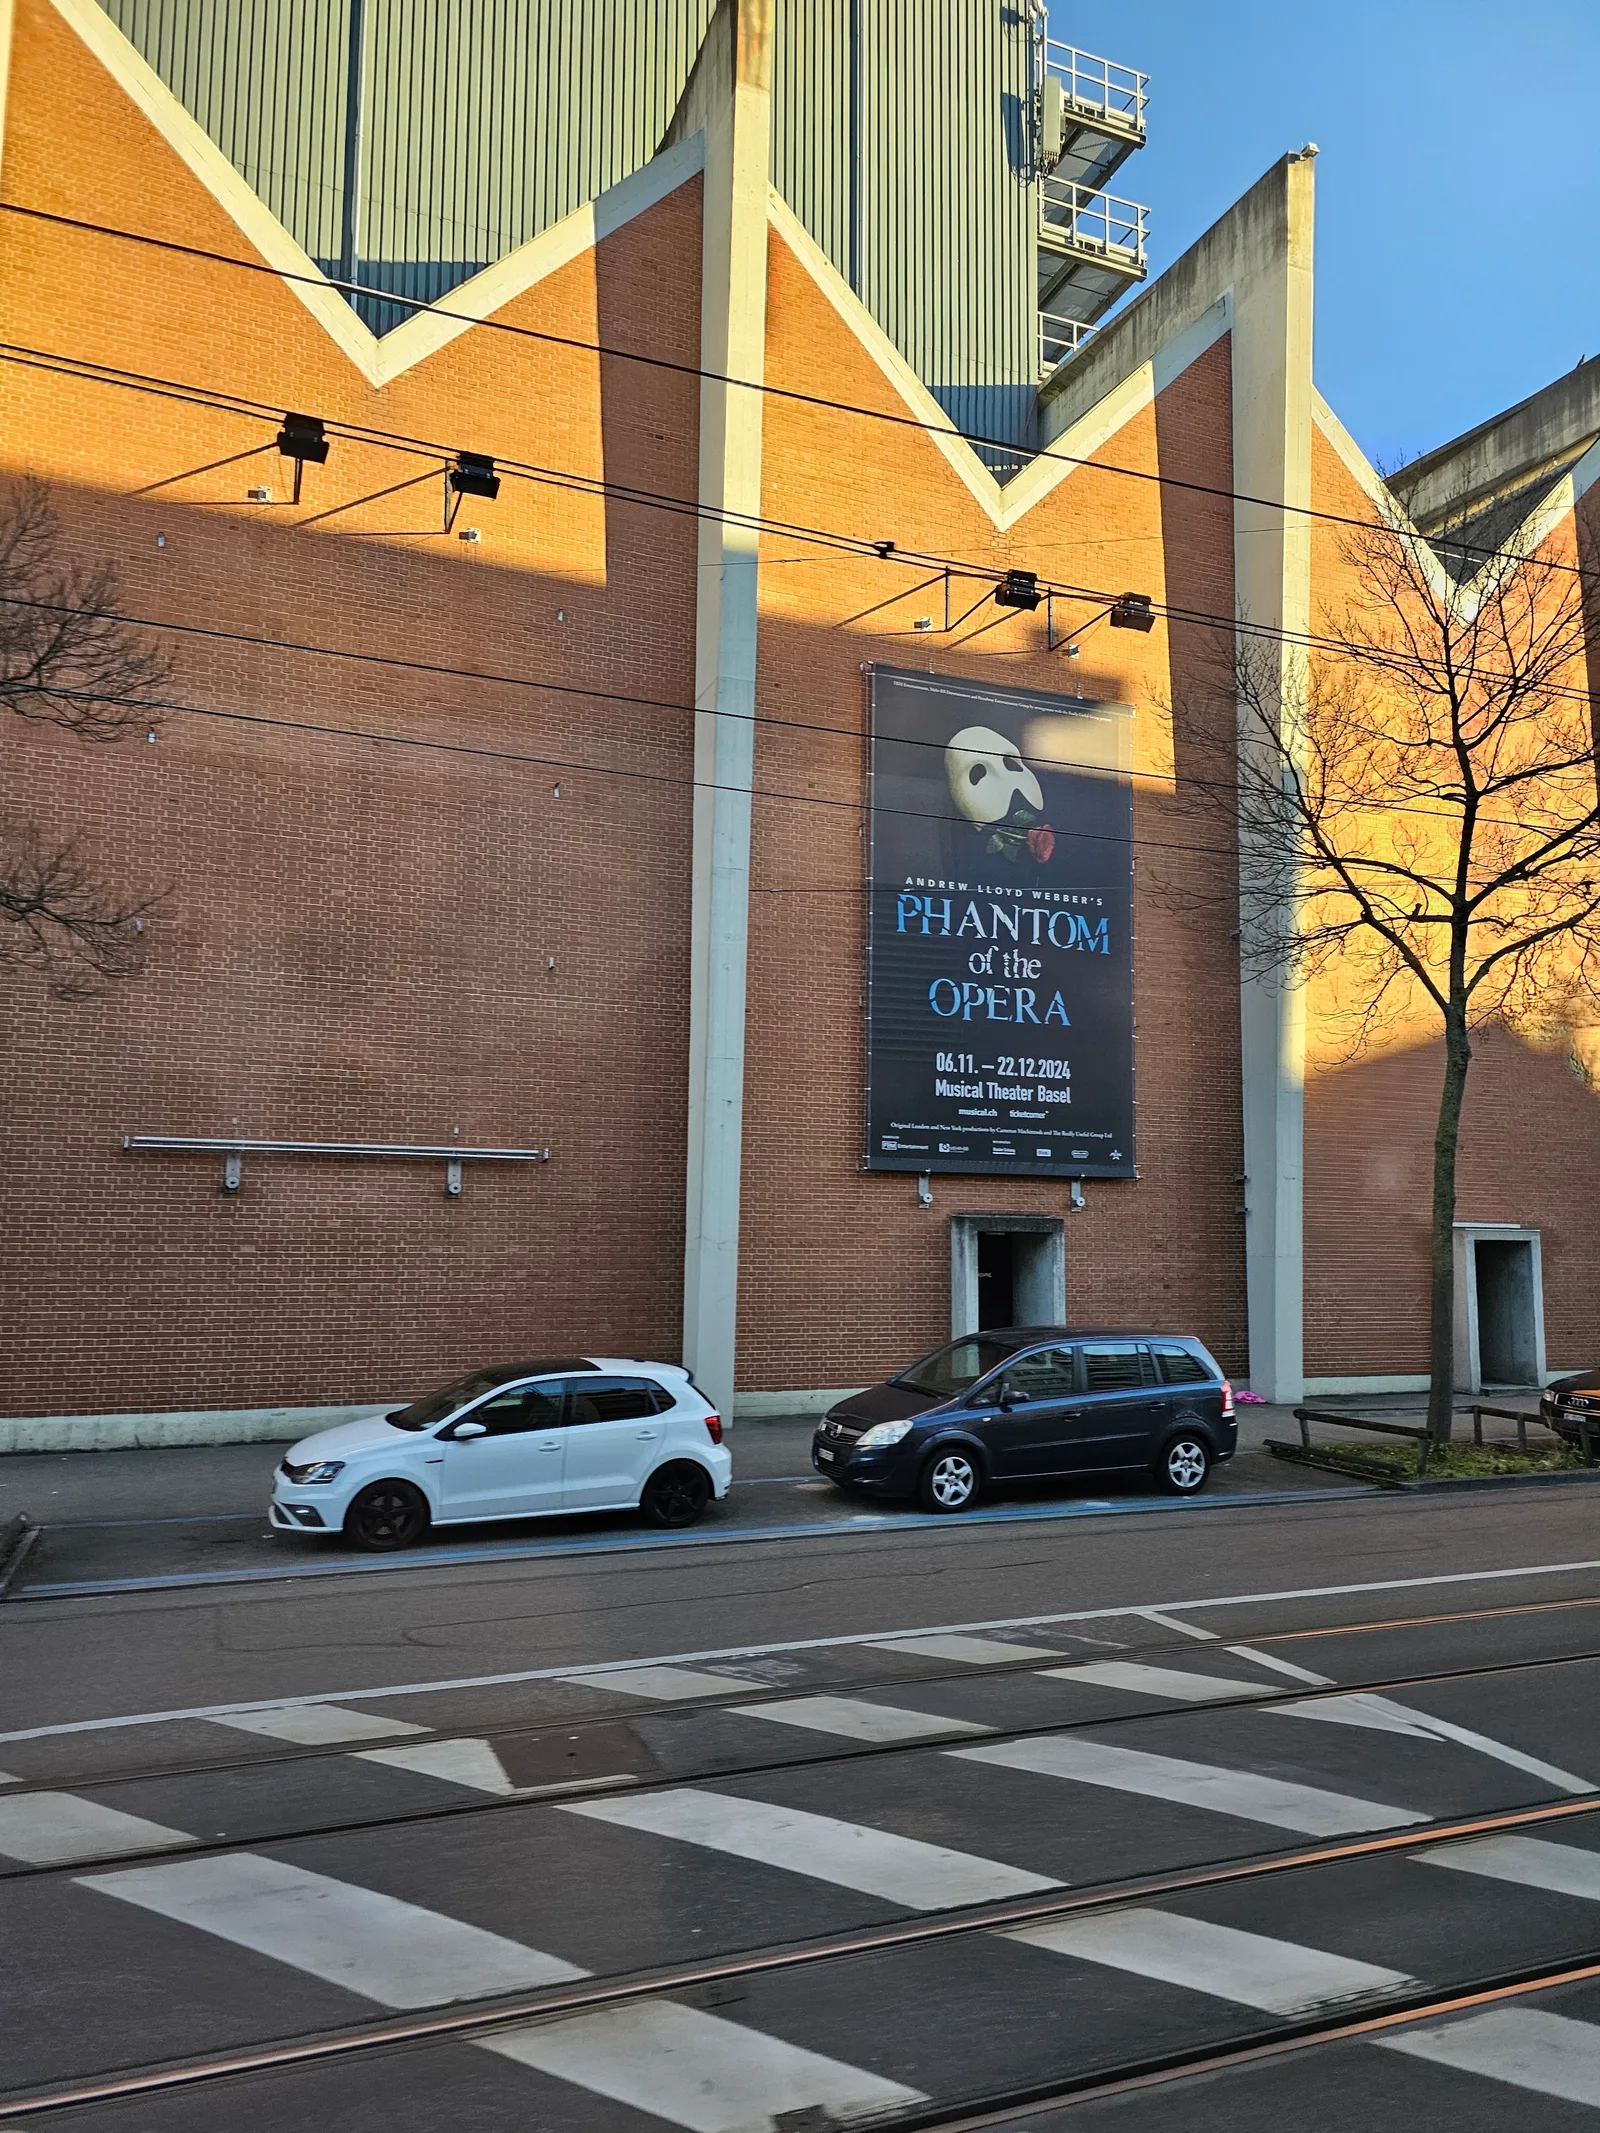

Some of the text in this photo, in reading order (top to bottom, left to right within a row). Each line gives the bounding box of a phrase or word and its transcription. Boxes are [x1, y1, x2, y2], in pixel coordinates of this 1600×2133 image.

[905, 876, 1103, 906] ANDREW LLOYD WEBBER'S
[896, 893, 1111, 955] PHANTOM
[968, 945, 1042, 979] of the
[929, 978, 1072, 1026] OPERA
[936, 1052, 979, 1074] 06.11.
[997, 1056, 1071, 1080] 22.12.2024
[935, 1078, 1072, 1104] Musical Theater Basel
[890, 1122, 911, 1130] Original
[958, 1108, 998, 1117] musical.ch
